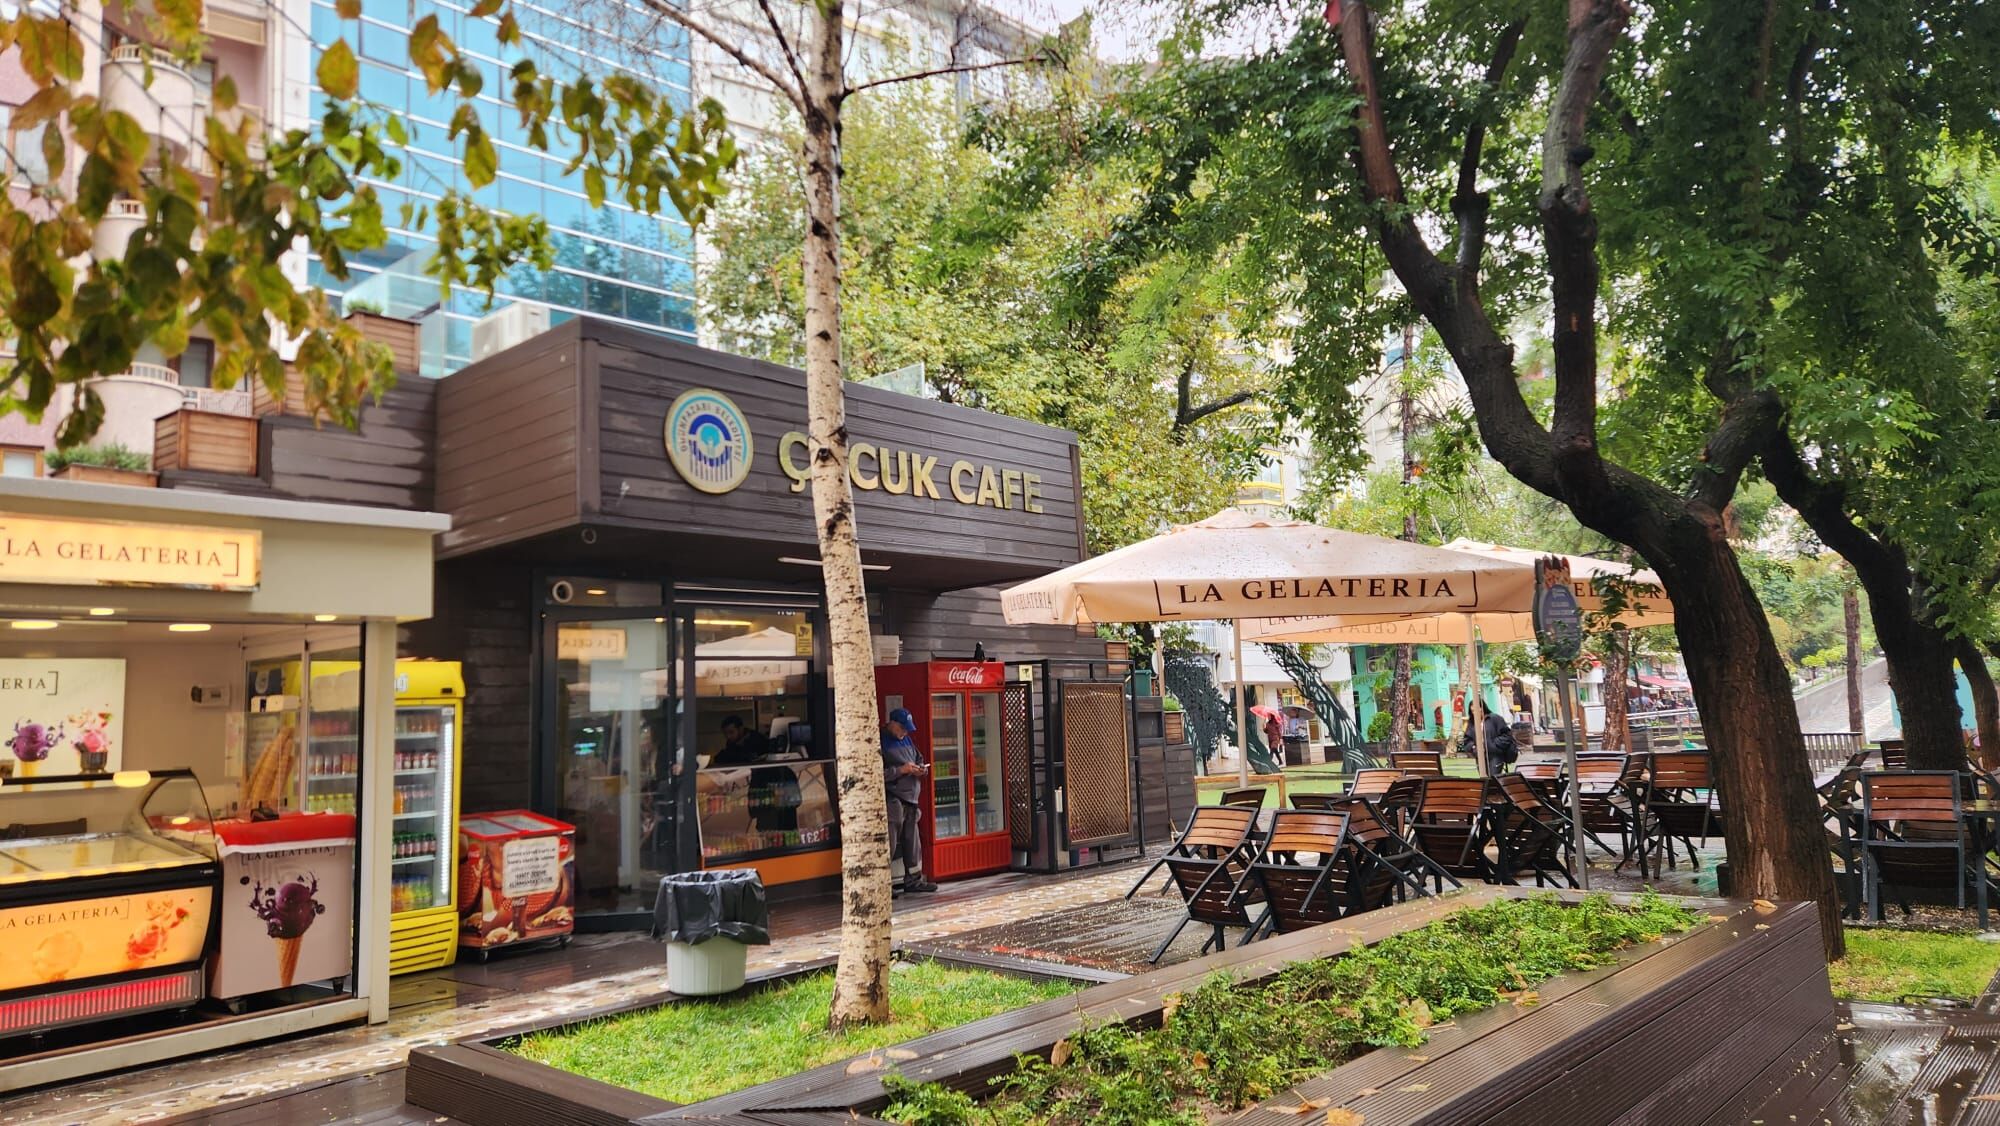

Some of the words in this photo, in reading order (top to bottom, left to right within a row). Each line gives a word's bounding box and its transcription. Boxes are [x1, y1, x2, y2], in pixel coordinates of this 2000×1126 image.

[778, 431, 941, 500] ÇCUK
[950, 460, 1044, 514] CAFE
[7, 538, 41, 557] LA
[57, 541, 222, 567] GELATERIA
[1178, 583, 1224, 604] LA
[1241, 578, 1457, 600] GELATERIA
[1, 677, 46, 690] ERIA
[266, 846, 330, 859] GELATERIA
[0, 917, 16, 929] A
[24, 905, 119, 927] GELATERIA
